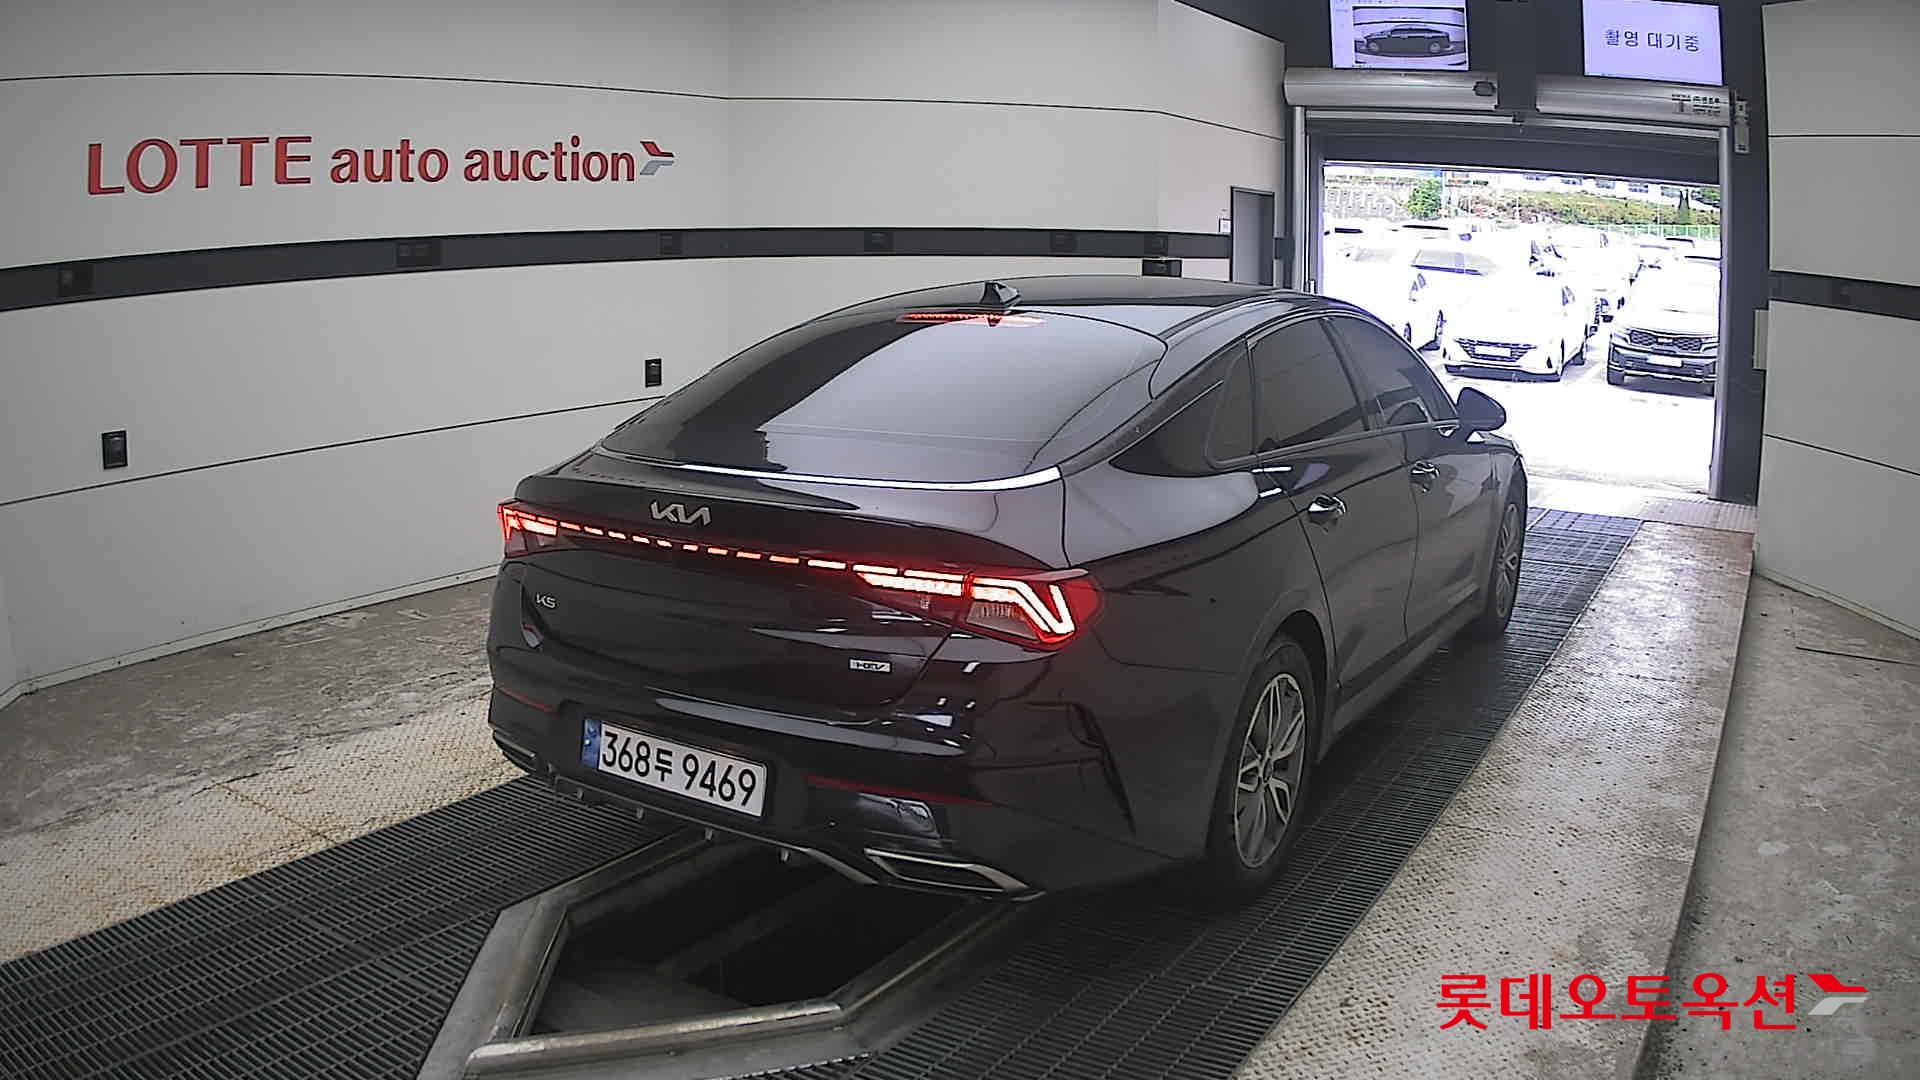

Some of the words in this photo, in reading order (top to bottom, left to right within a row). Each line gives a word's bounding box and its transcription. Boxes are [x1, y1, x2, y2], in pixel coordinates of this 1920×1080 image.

[1605, 29, 1639, 47] 촬영
[1647, 32, 1699, 52] 대기중
[87, 136, 312, 195] LOTTE
[330, 139, 449, 183] auto
[463, 135, 635, 182] auction
[650, 501, 711, 526] KIA
[602, 730, 673, 782] 368두
[682, 753, 757, 806] 9469
